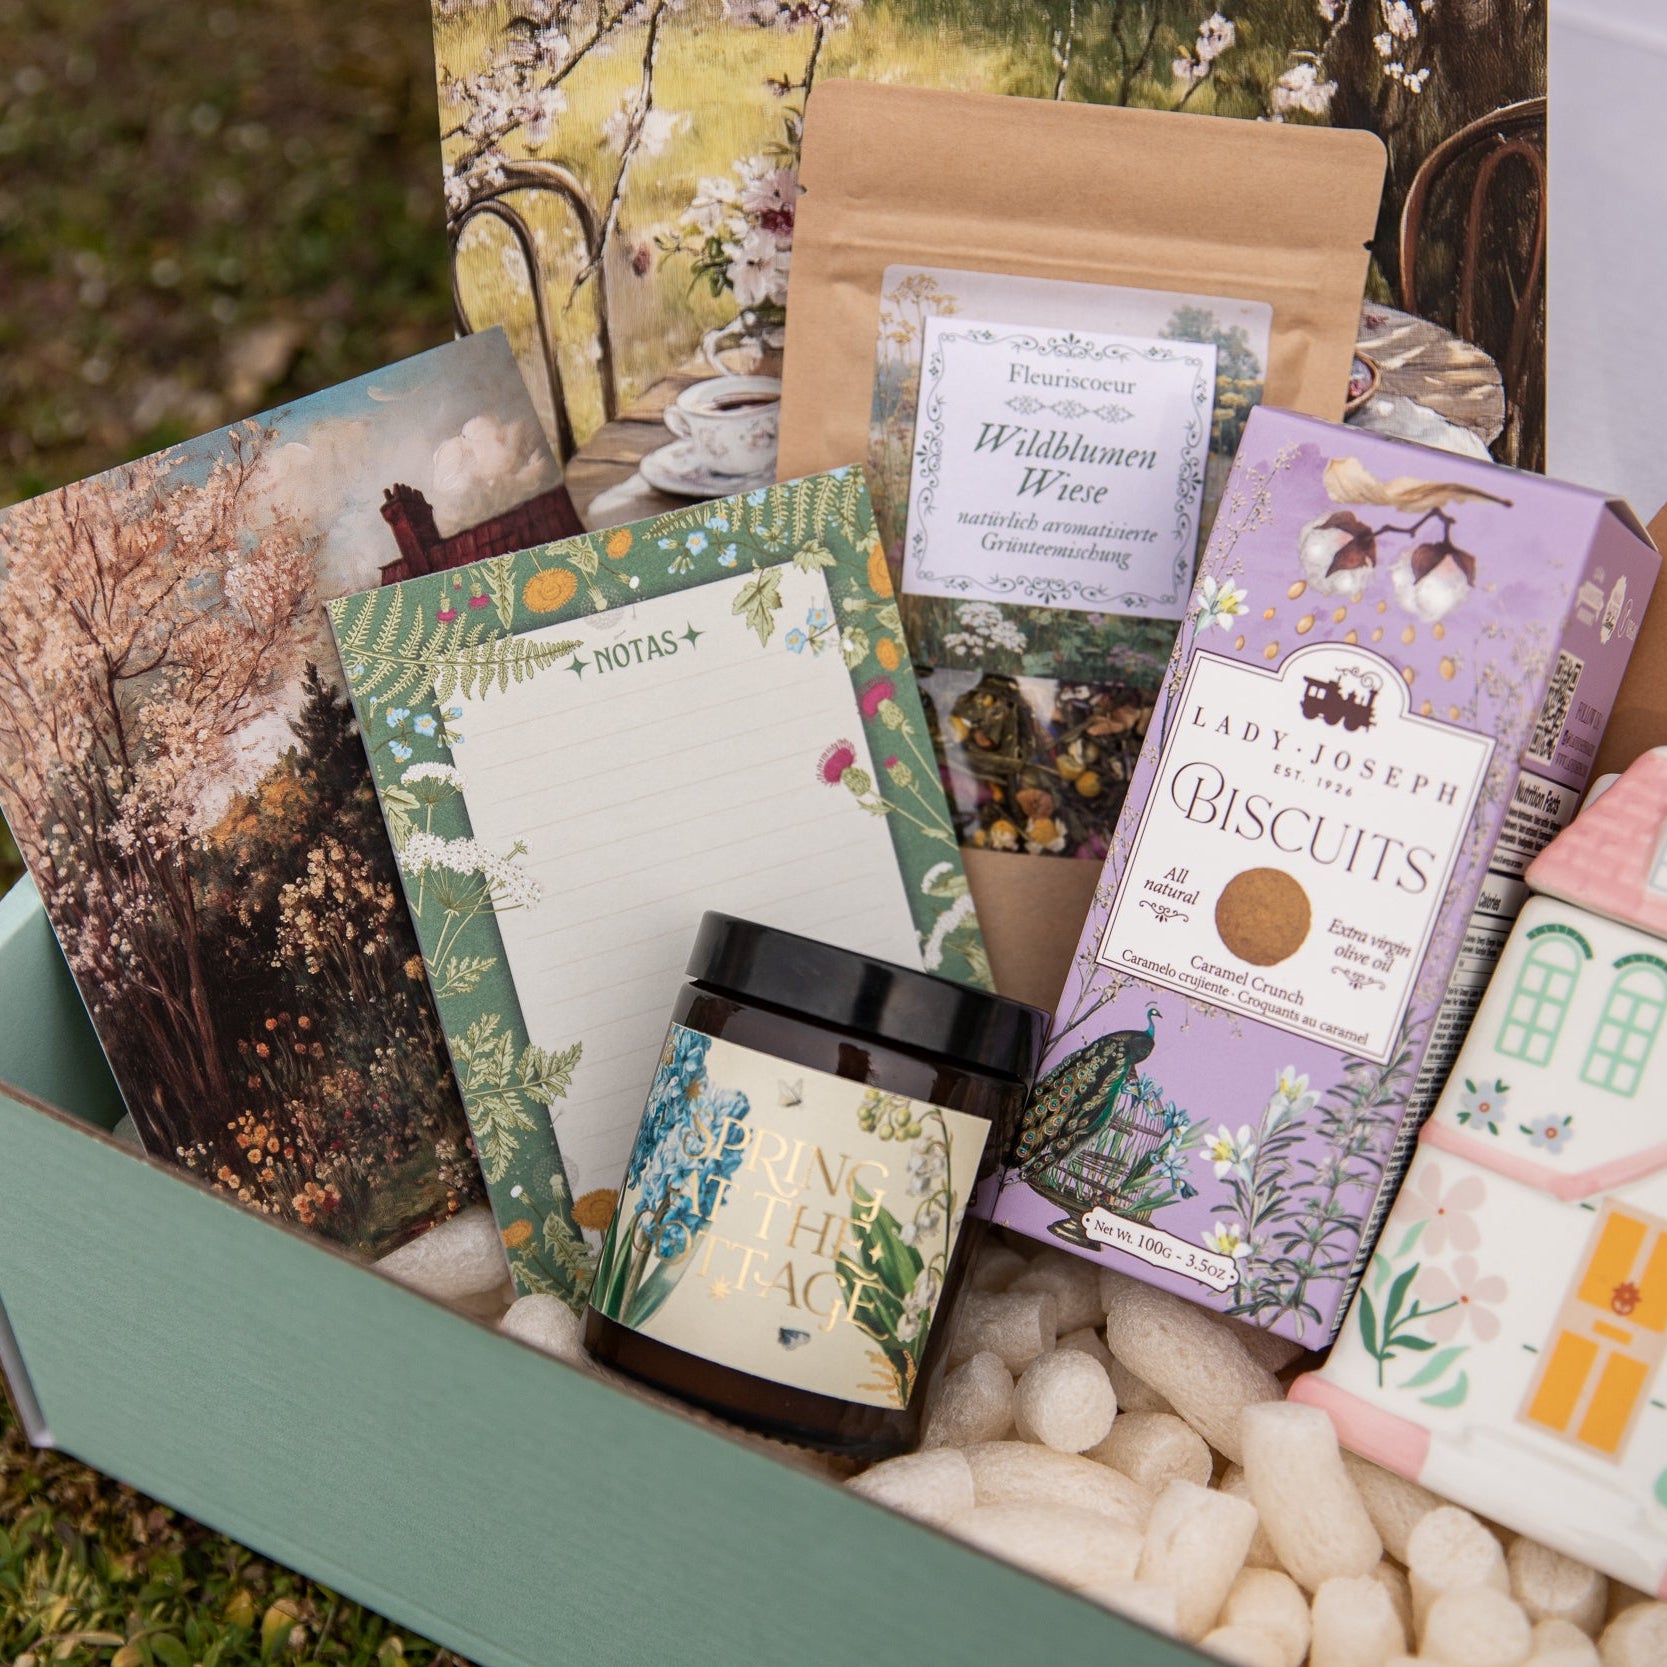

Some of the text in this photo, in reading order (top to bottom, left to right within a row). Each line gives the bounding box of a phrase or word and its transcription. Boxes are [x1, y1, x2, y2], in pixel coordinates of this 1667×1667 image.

[1009, 362, 1136, 394] Fleuriscoeur
[974, 422, 1157, 469] Wildblumen
[1016, 466, 1108, 504] Wiese
[957, 511, 1158, 543] natürlich aromatisierte
[981, 532, 1131, 571] Grünteemischung
[593, 630, 678, 674] NOTAS
[1192, 706, 1289, 751] LADY
[1310, 744, 1458, 805] JOSEPH
[1273, 763, 1353, 797] EST. 1926
[1171, 762, 1436, 894] BISCUITS
[1143, 878, 1200, 905] natural
[1163, 866, 1190, 884] All
[1327, 918, 1411, 959] Extra virgin
[1334, 943, 1395, 973] olive oil
[1122, 949, 1176, 977] Caramelo
[1178, 970, 1229, 996] crujiente
[1238, 989, 1300, 1021] Croquants
[1303, 1016, 1317, 1026] au
[1320, 1020, 1368, 1046] caramel
[1190, 955, 1304, 1005] Caramel Crunch
[682, 1108, 889, 1223] SPRING
[667, 1168, 880, 1280] AT THE
[1094, 1219, 1113, 1235] Net
[1117, 1228, 1133, 1244] Wt.
[632, 1209, 889, 1342] COTTAGE
